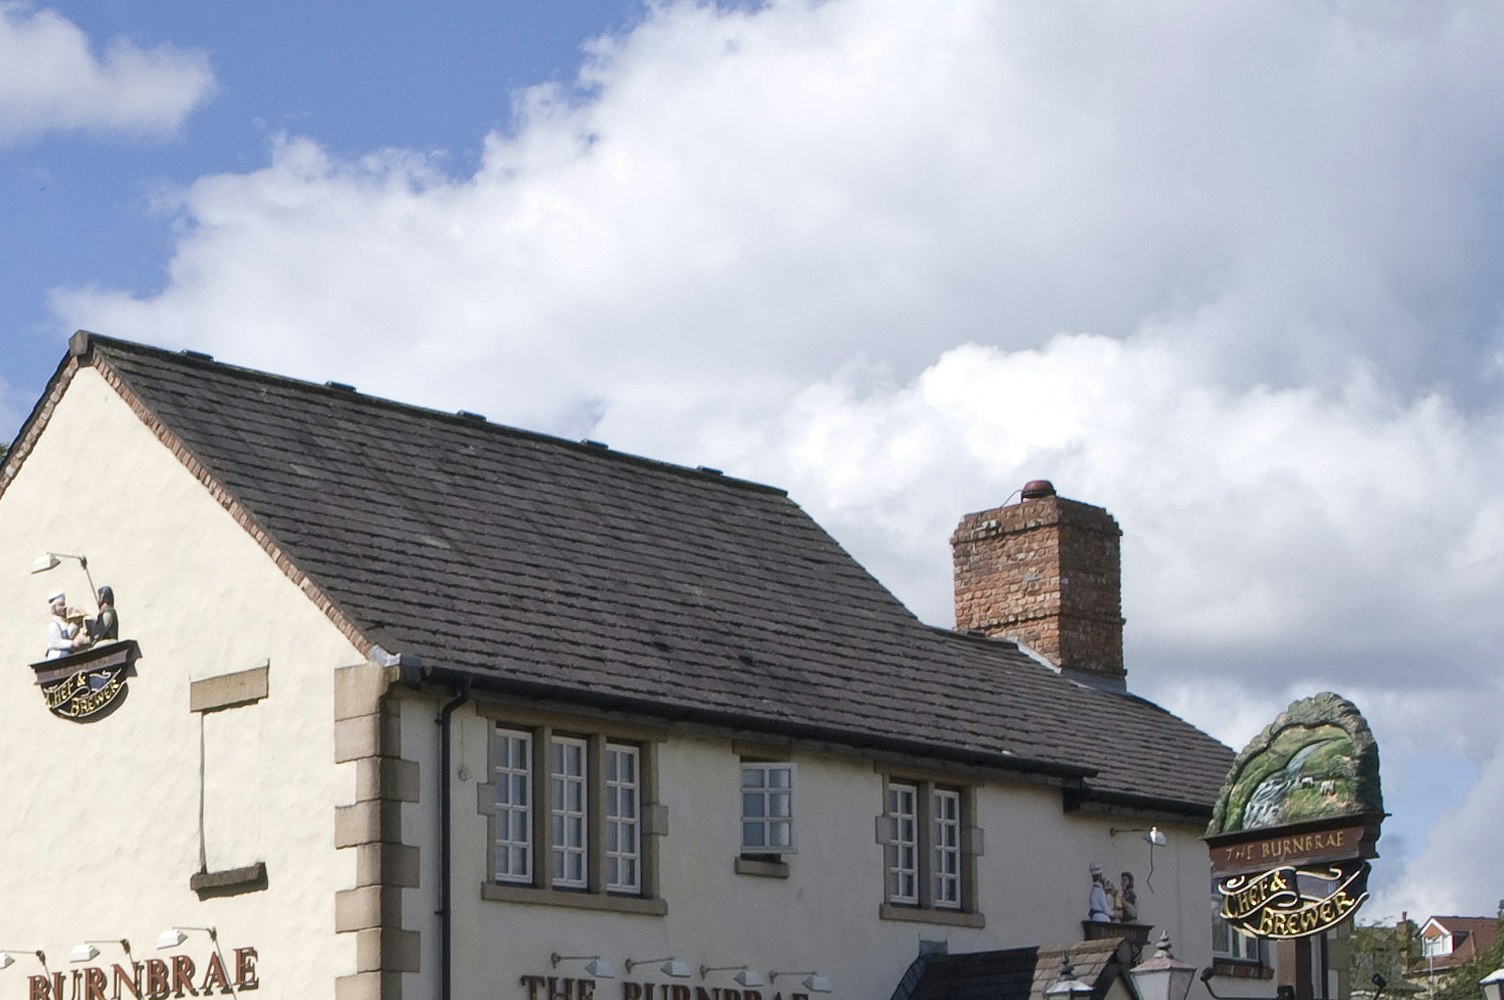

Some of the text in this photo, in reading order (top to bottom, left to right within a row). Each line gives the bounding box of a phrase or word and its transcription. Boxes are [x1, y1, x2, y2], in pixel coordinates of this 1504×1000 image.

[1225, 831, 1344, 861] THE BURNBRAE
[1223, 870, 1287, 919] CHEF &
[1259, 891, 1355, 936] BREWER
